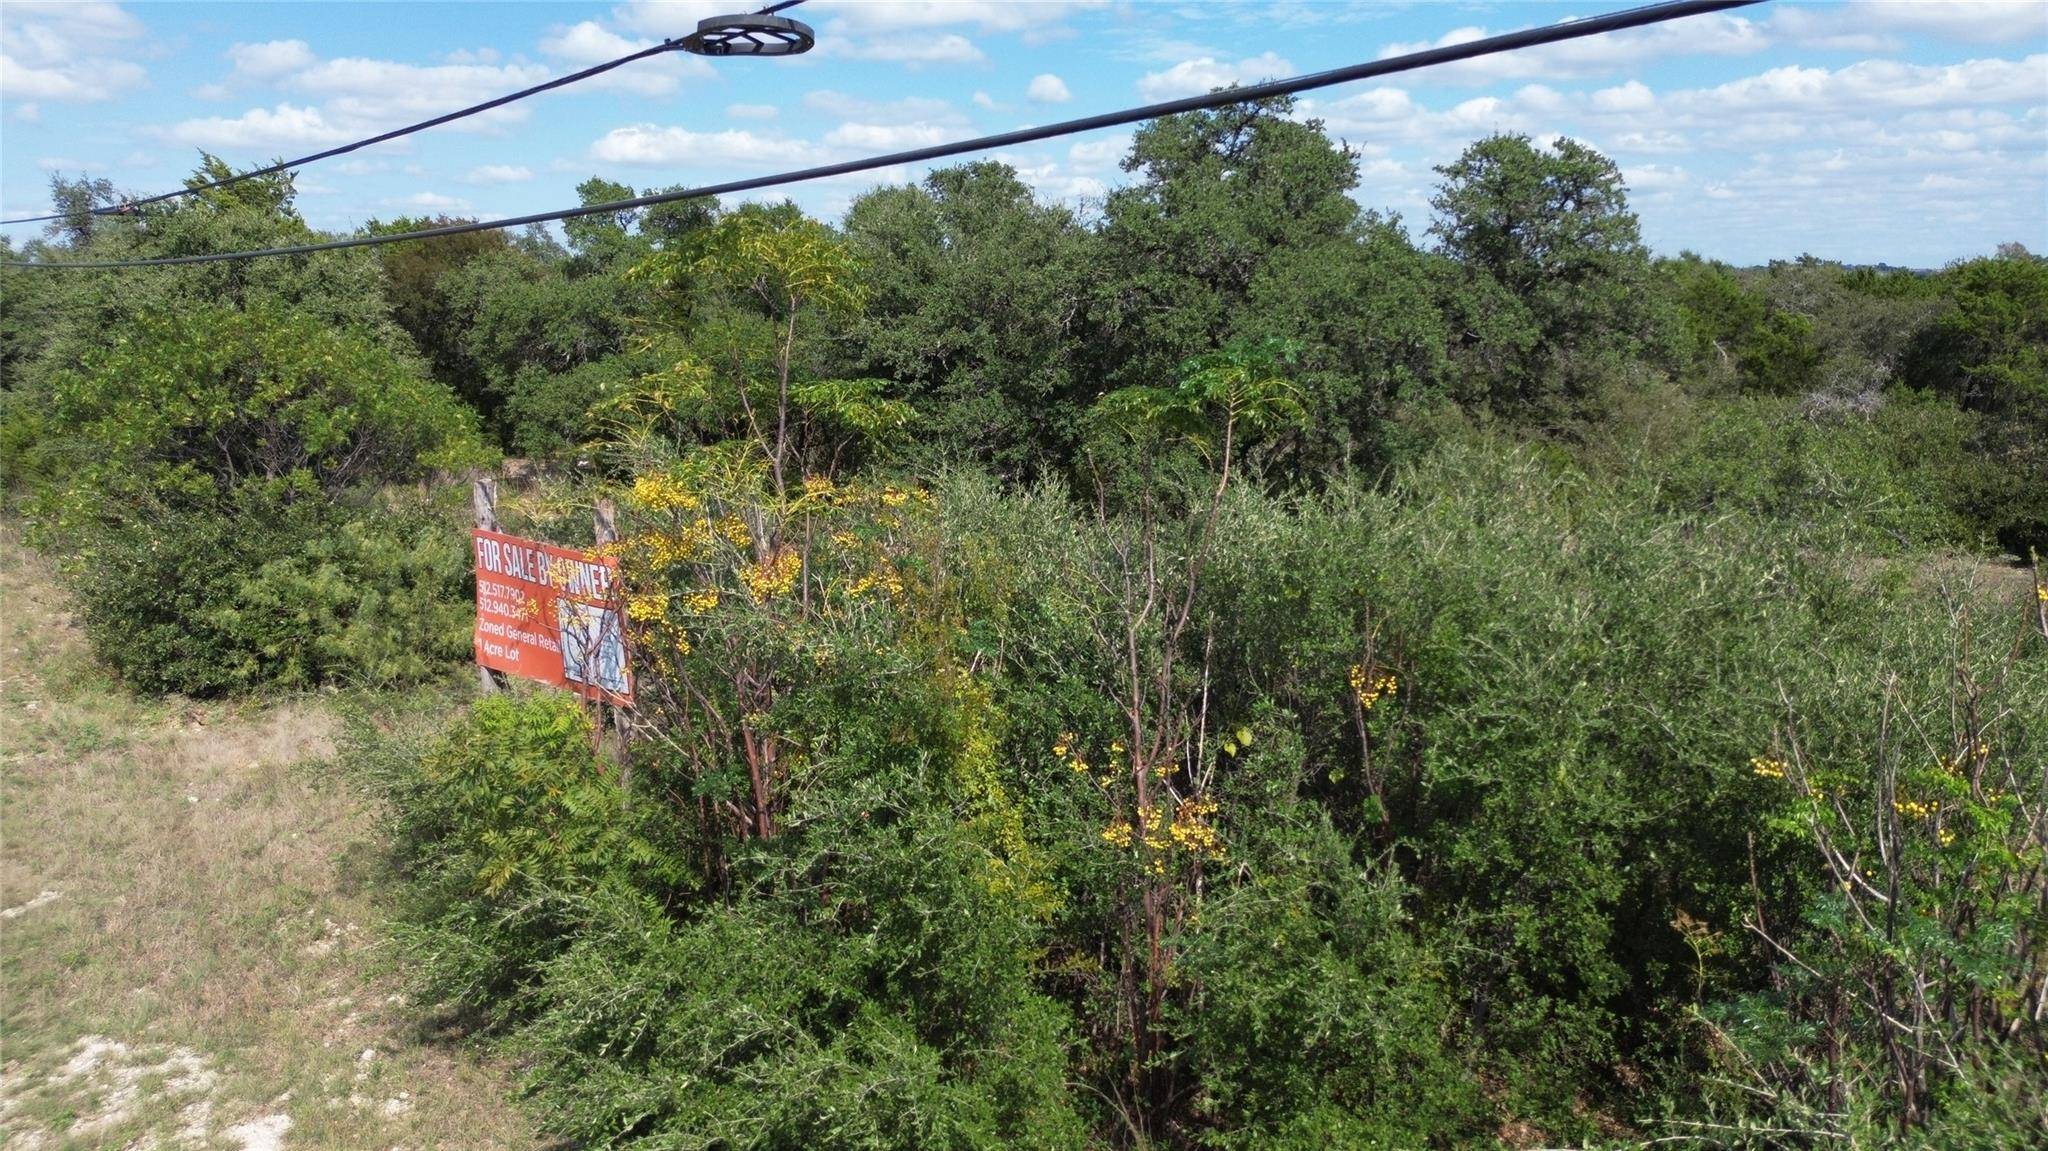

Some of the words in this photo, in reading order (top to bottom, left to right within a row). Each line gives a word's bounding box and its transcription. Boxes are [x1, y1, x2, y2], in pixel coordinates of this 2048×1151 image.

[476, 537, 502, 573] FOR
[503, 542, 537, 583] SALE
[536, 550, 553, 587] BY
[479, 618, 504, 636] Zoned
[507, 625, 537, 646] General
[538, 634, 561, 654] Retail
[484, 640, 503, 657] Acre
[505, 646, 519, 661] Lot
